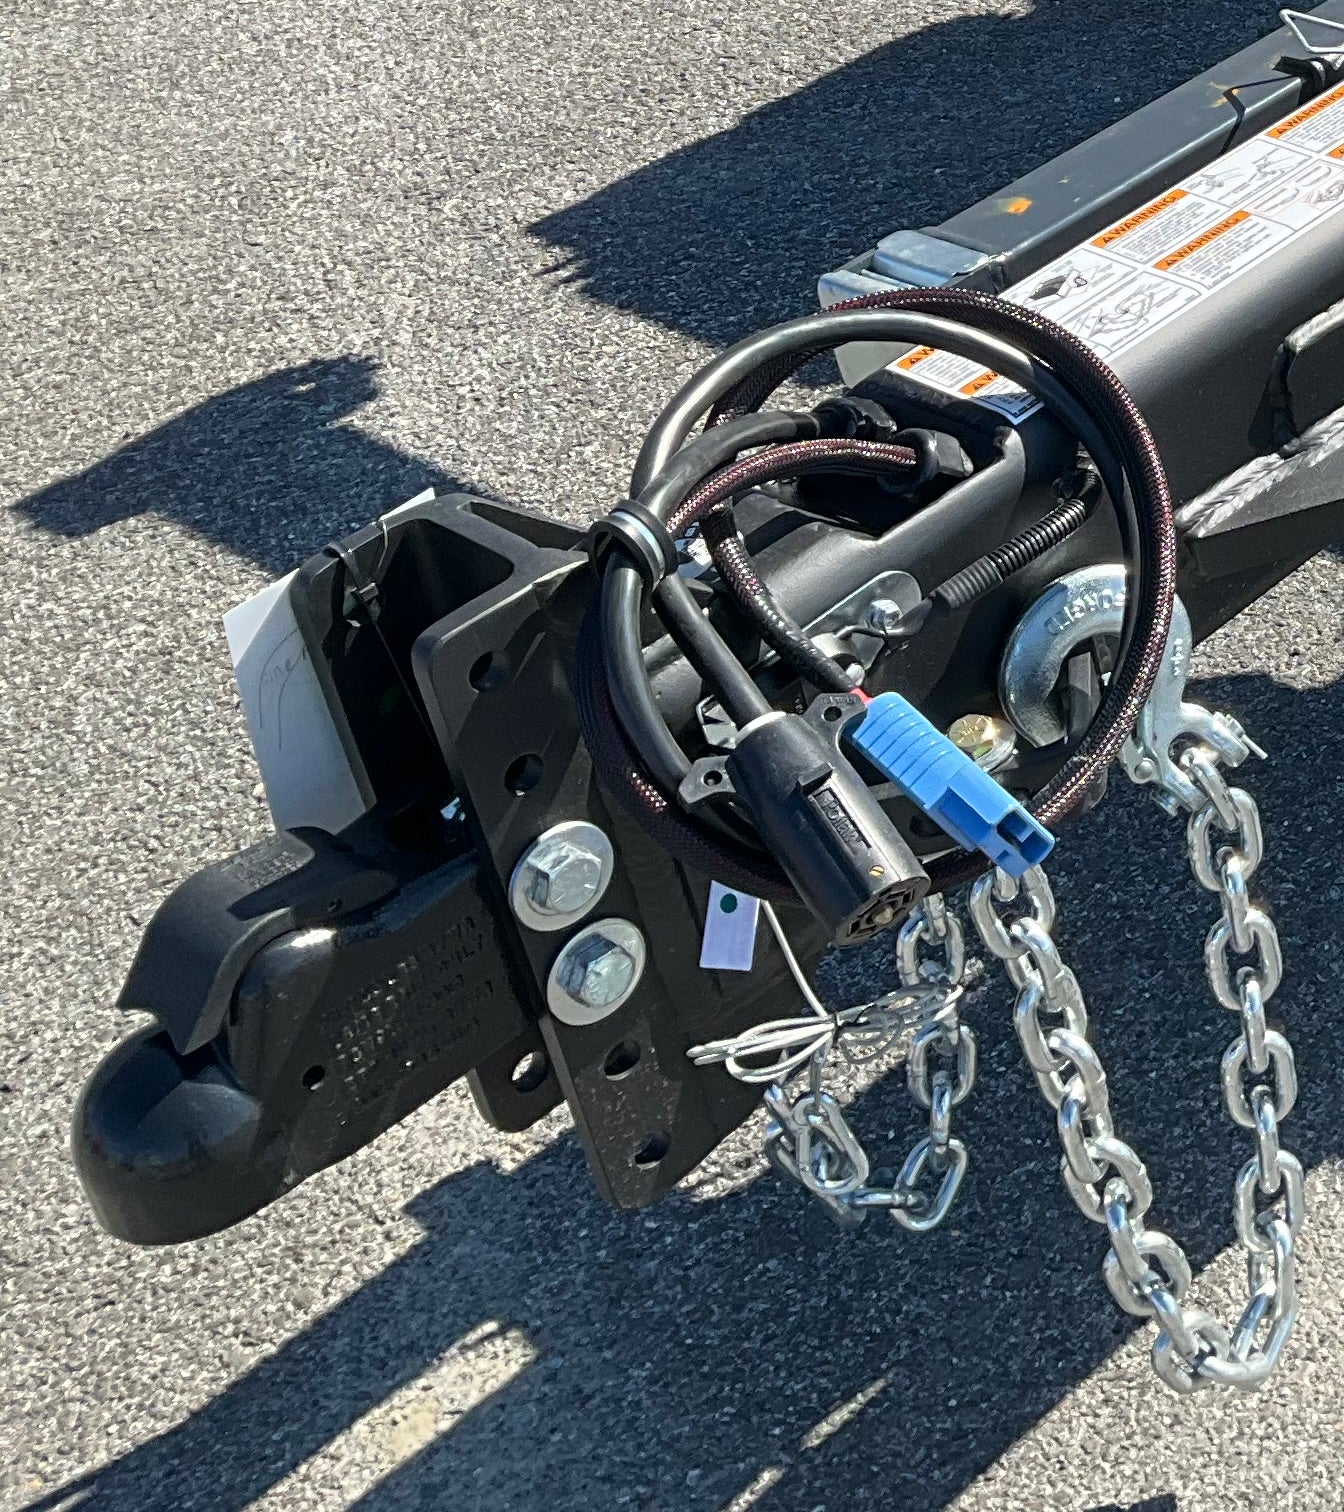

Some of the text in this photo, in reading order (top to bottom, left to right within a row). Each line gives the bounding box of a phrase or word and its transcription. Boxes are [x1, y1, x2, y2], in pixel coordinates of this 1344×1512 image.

[1286, 91, 1344, 127] WARNING
[1115, 196, 1177, 233] WARNING
[1176, 218, 1239, 257] WARNING
